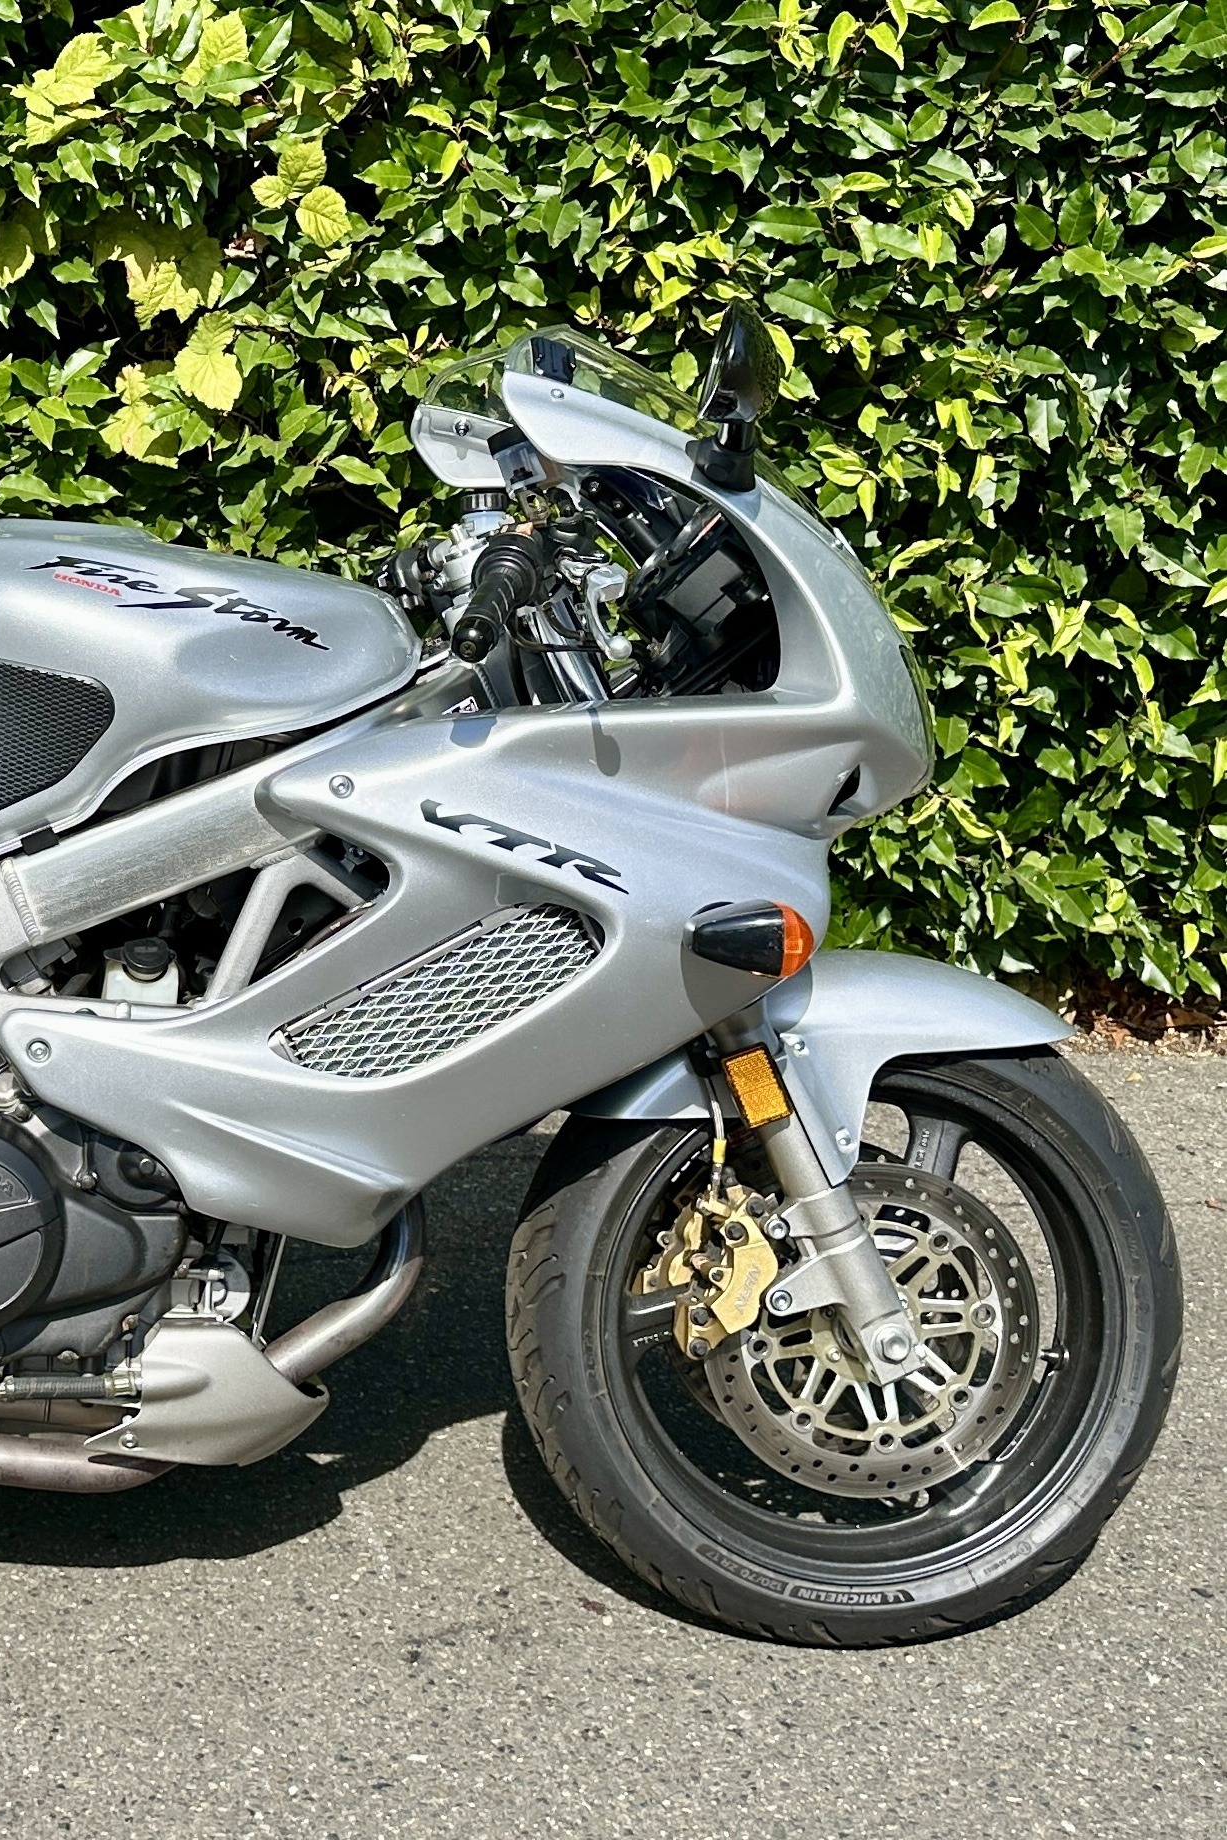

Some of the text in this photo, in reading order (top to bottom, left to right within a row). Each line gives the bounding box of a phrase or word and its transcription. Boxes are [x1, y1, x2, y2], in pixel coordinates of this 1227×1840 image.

[52, 570, 123, 598] HONDA
[420, 798, 630, 895] VTR
[705, 1550, 882, 1605] MICHELIN 120/70 ZR 17
